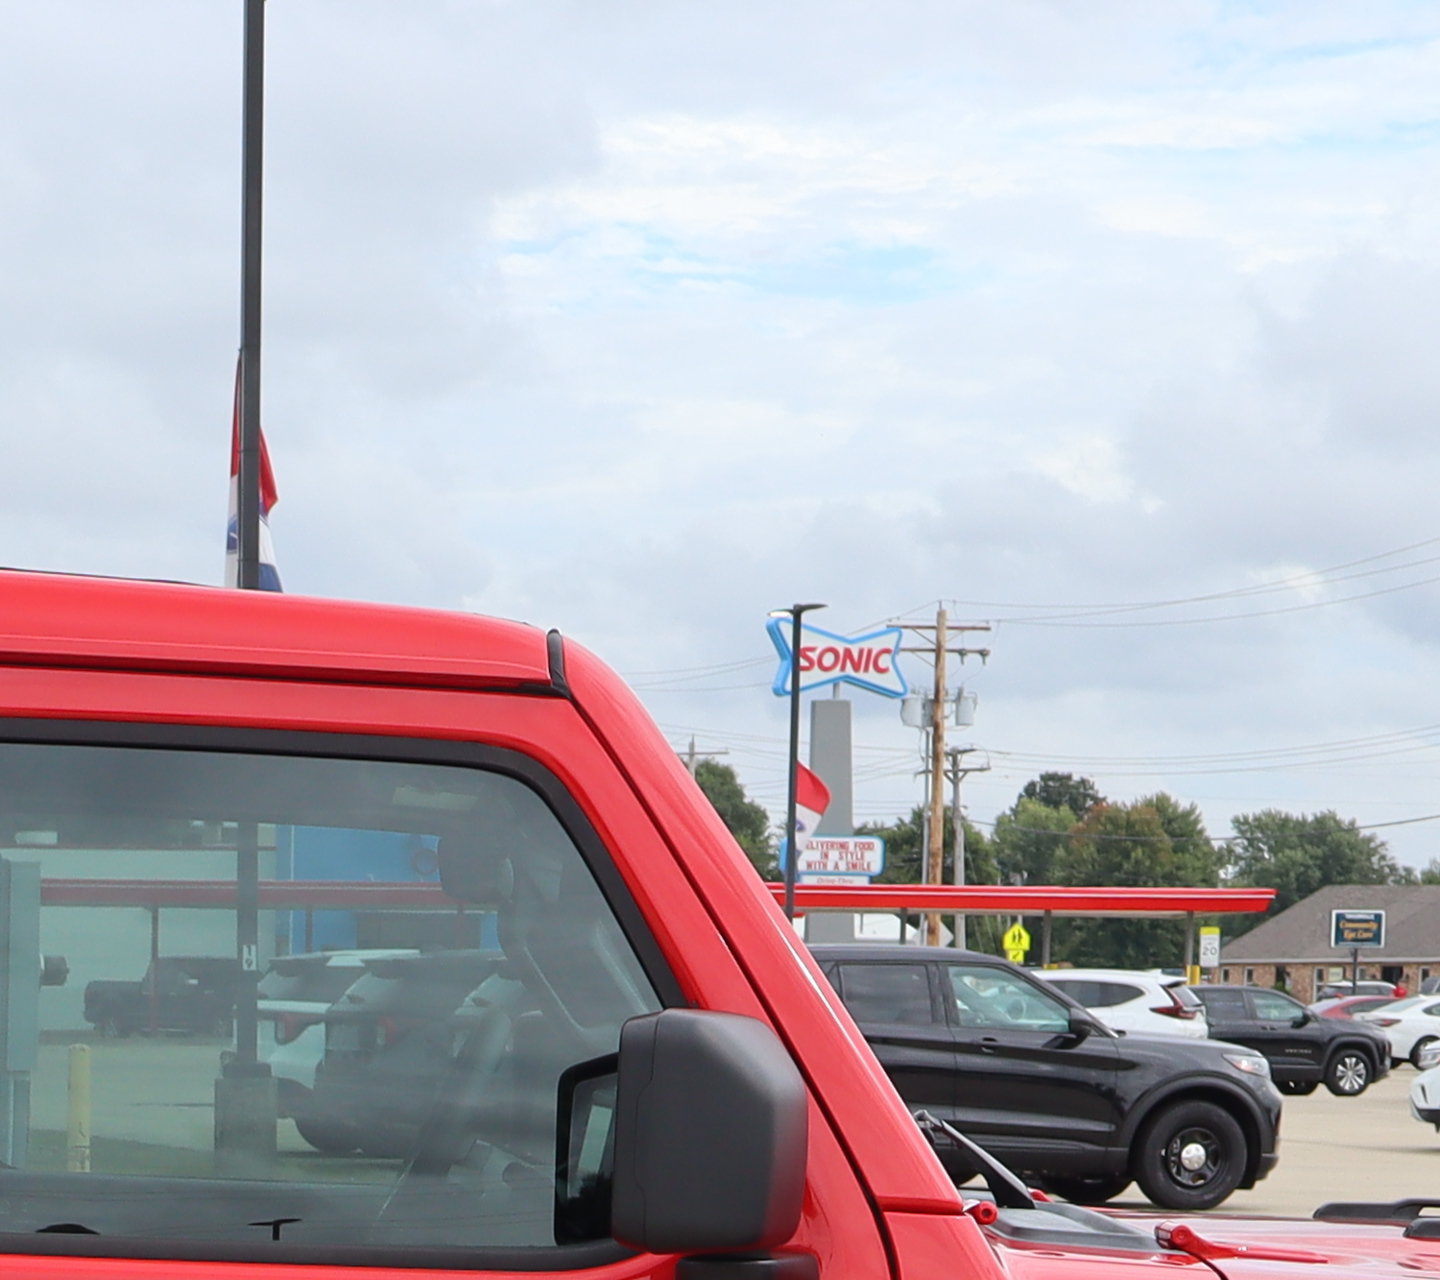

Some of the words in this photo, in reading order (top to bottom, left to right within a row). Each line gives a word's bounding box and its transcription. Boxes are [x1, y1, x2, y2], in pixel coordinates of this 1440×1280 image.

[798, 646, 893, 674] SONIC
[806, 841, 850, 851] ELIVERING
[855, 841, 875, 851] FOOD
[821, 852, 830, 860] IN
[839, 851, 864, 860] STYLE
[806, 861, 828, 871] WITH
[834, 862, 840, 871] A
[846, 861, 872, 872] SMILE
[1203, 946, 1217, 956] 20
